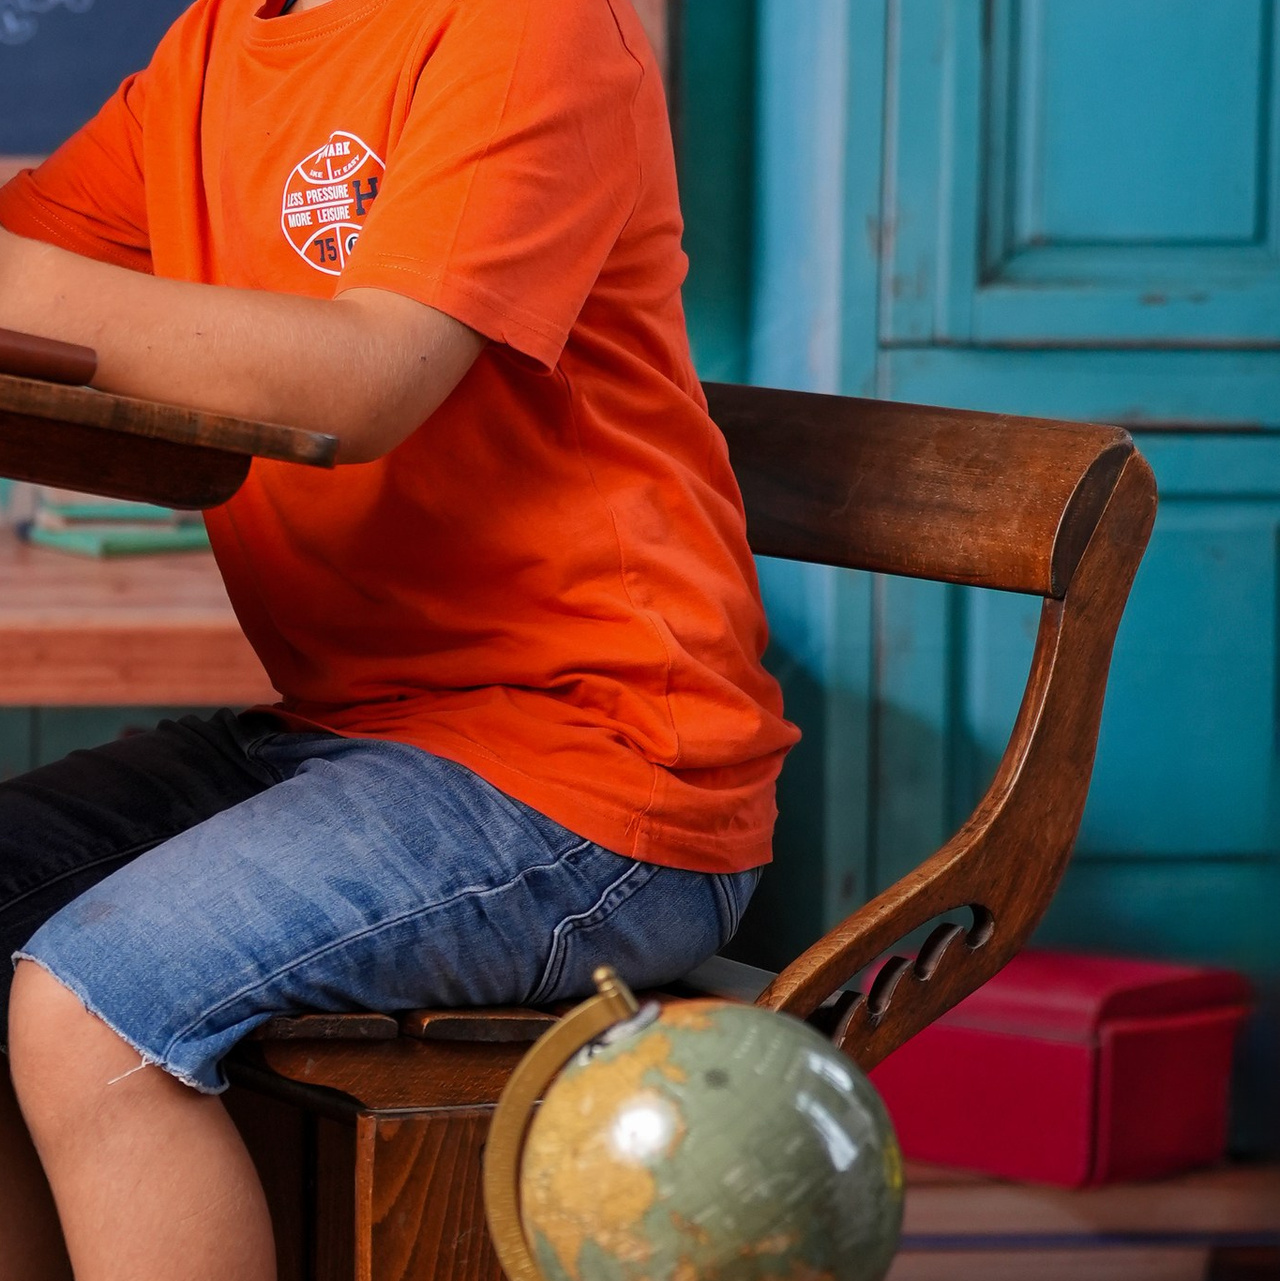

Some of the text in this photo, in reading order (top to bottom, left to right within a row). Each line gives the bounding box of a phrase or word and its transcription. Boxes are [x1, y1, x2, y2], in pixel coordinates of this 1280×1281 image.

[287, 184, 349, 207] LESS PRESSURE
[287, 205, 350, 228] MORE LEISURE
[314, 238, 338, 262] 75
